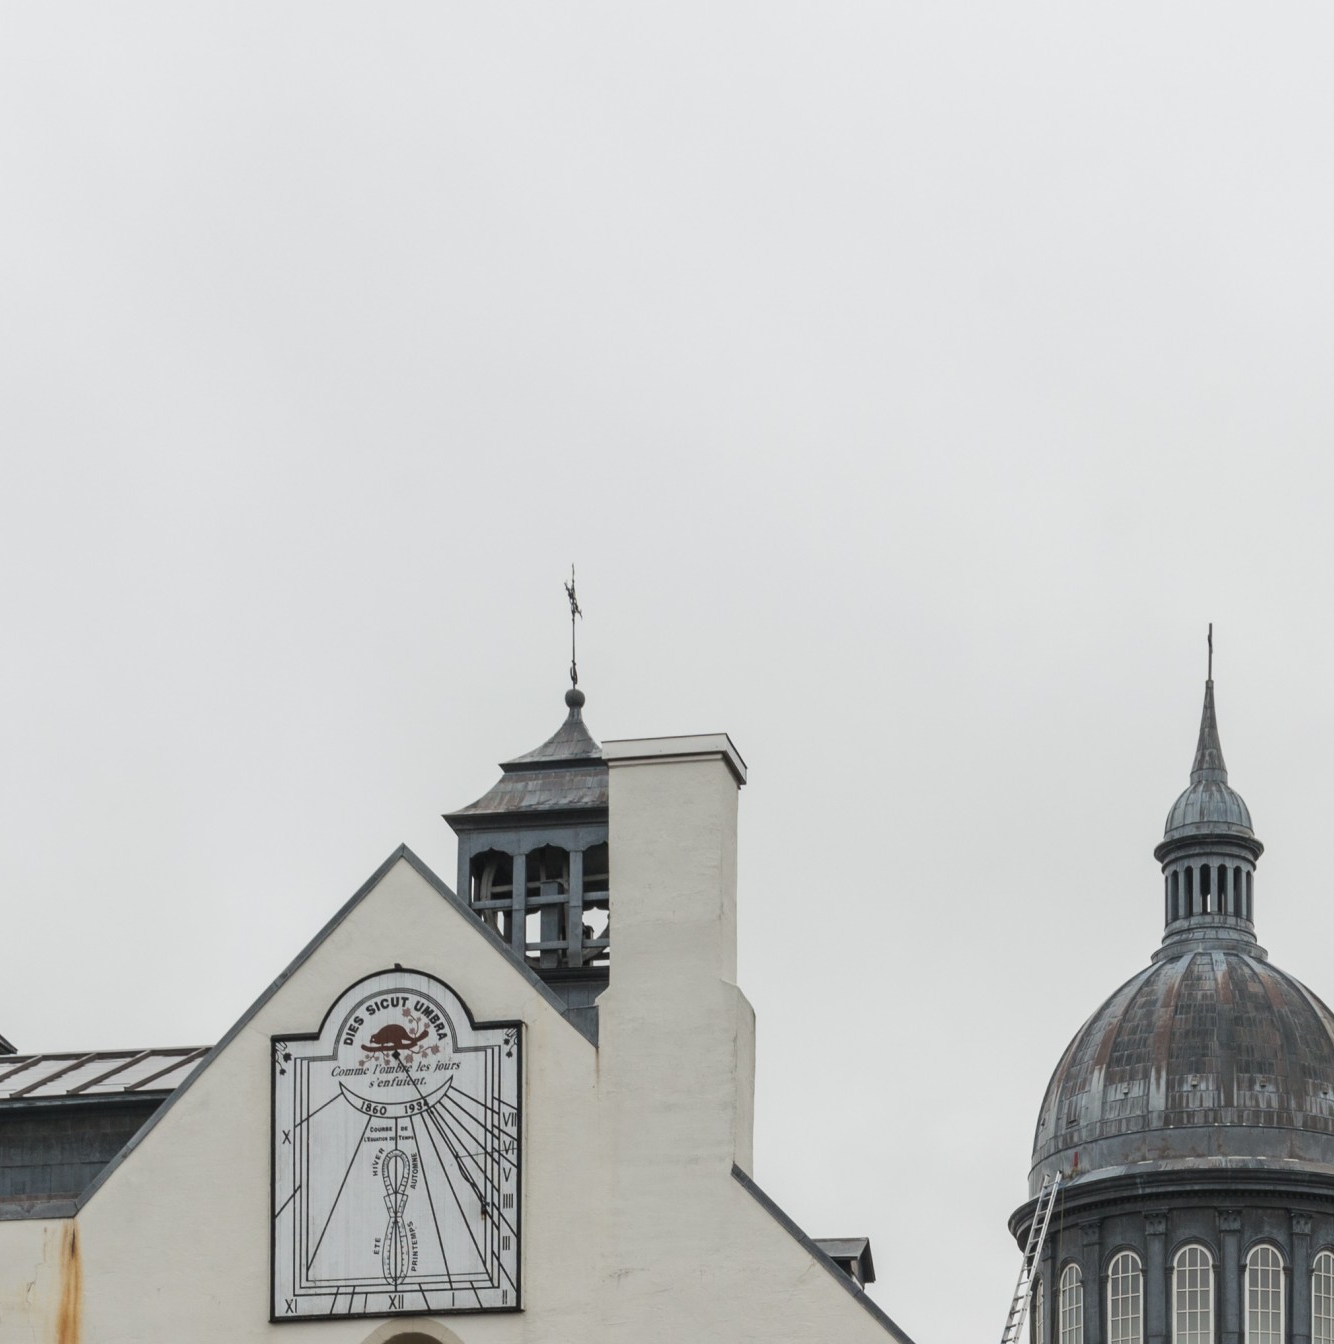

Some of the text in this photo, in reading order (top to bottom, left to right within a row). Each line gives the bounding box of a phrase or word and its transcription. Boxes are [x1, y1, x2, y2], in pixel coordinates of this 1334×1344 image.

[344, 997, 447, 1046] DIES SICUT UMBRA
[331, 1060, 461, 1077] Comme l'ombre les jours
[369, 1076, 427, 1088] s'enfuient.
[360, 1100, 427, 1115] 1860 1934
[503, 1112, 516, 1127] VII
[282, 1130, 291, 1144] X
[503, 1140, 514, 1155] VI
[372, 1148, 385, 1176] HIVER
[410, 1152, 418, 1189] AUTOMNE
[503, 1167, 511, 1182] V
[407, 1221, 418, 1272] PRINTEMPS
[285, 1299, 297, 1314] XI
[388, 1294, 404, 1309] XII
